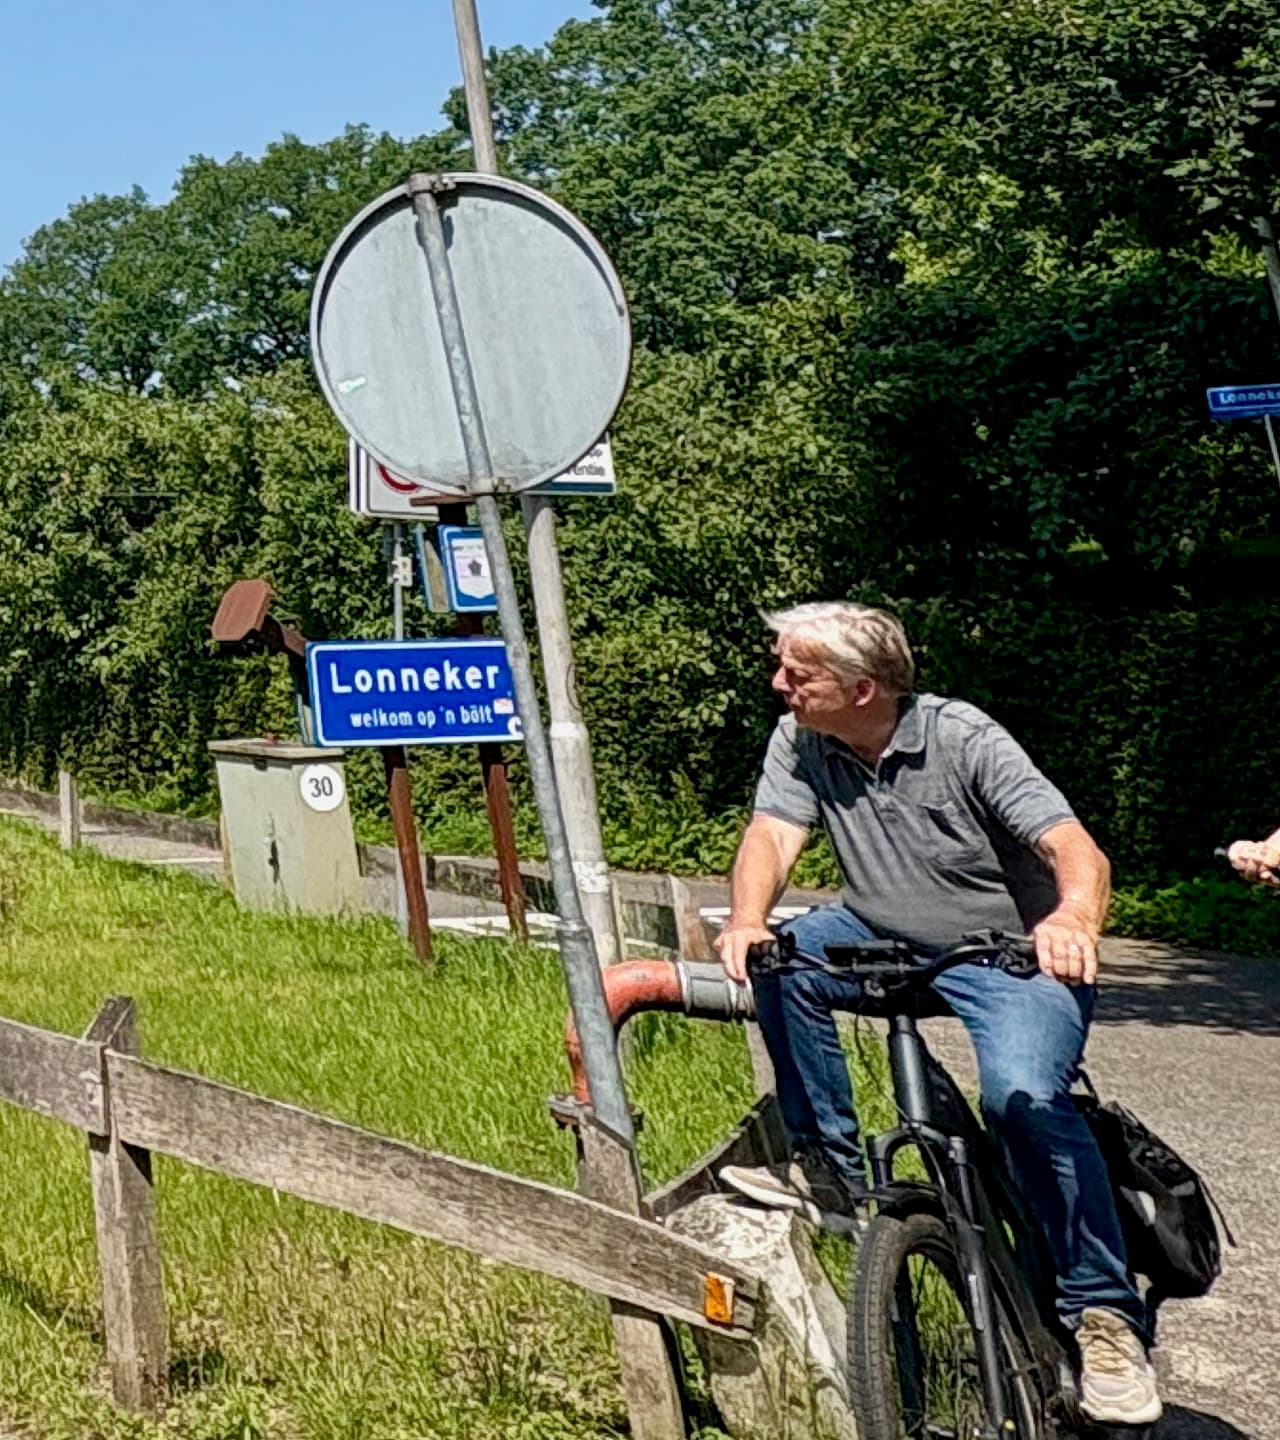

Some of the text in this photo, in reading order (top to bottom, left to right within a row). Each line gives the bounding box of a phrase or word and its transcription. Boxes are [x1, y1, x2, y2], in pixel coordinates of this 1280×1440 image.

[329, 660, 499, 694] Lonneker
[350, 708, 413, 728] welkom
[417, 710, 437, 729] op
[439, 705, 456, 725] 'n
[309, 775, 333, 798] 30
